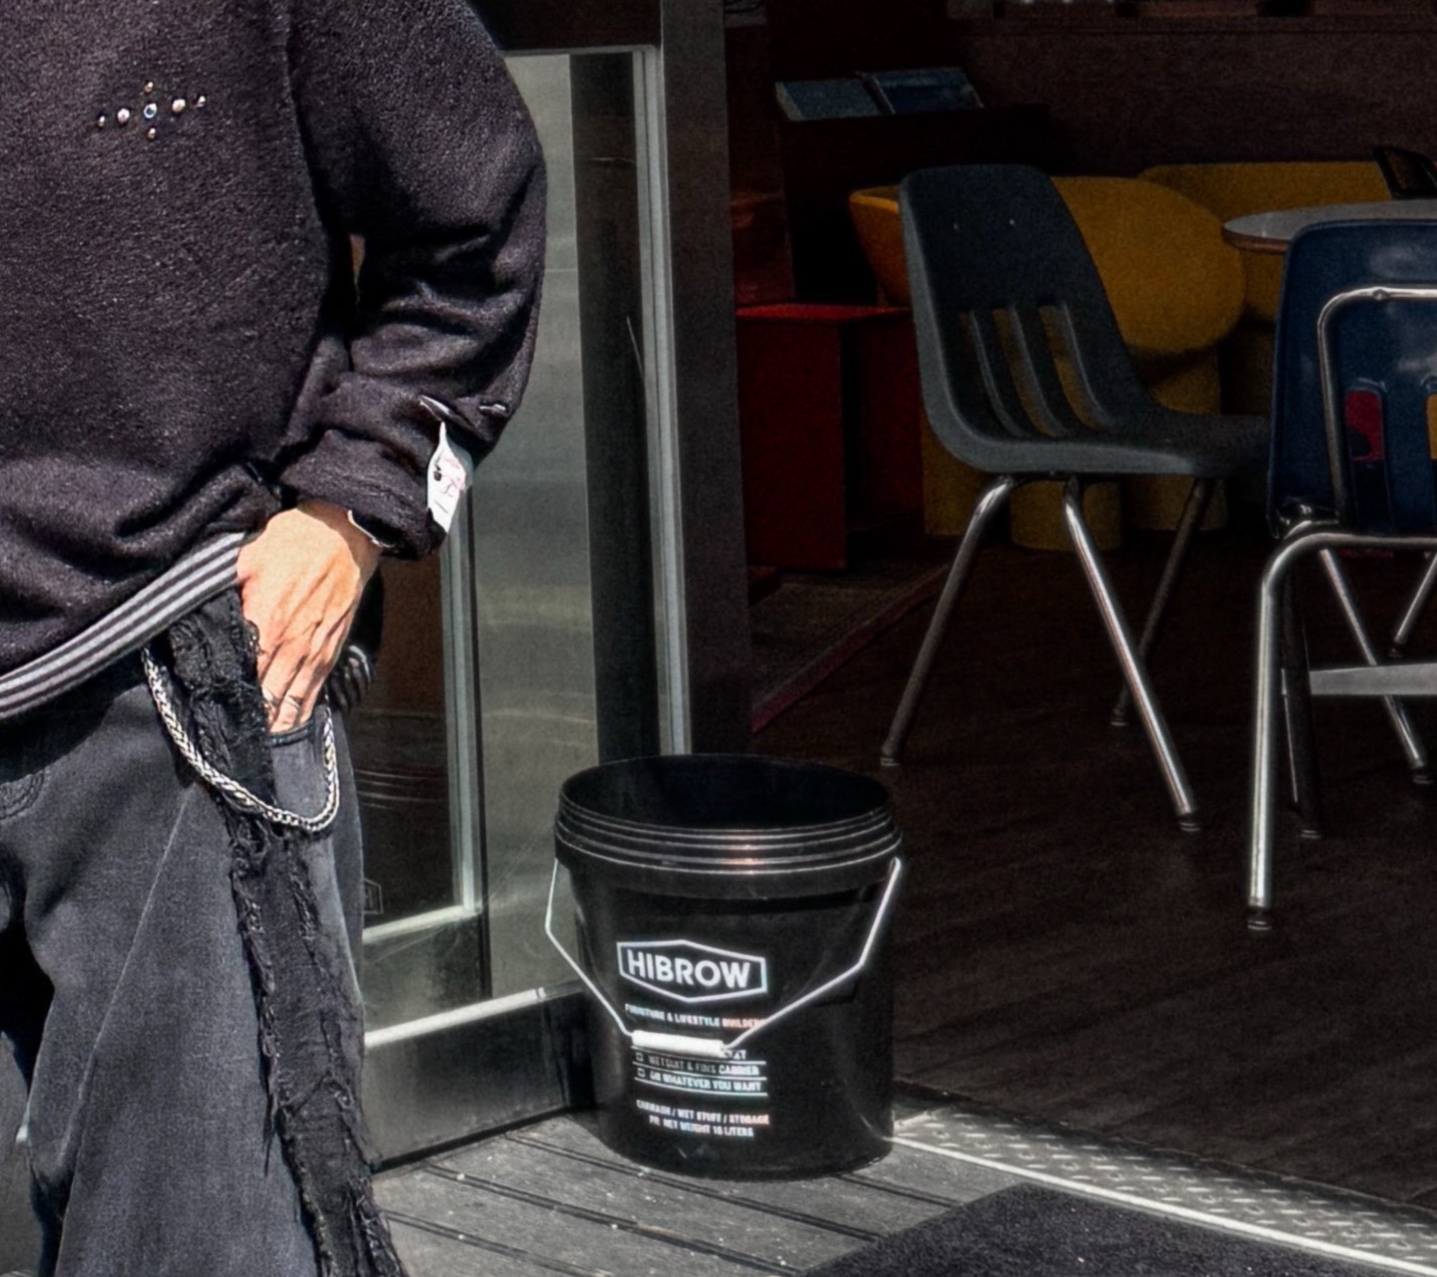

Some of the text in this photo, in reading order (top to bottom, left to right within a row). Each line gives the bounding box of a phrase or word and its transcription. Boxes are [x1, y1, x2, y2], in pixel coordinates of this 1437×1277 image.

[627, 949, 750, 989] HIBROW
[674, 1013, 720, 1027] LIFESTYLE
[663, 1073, 711, 1089] WHATEVER
[713, 1079, 732, 1091] YOU
[733, 1081, 762, 1091] WANT
[696, 1111, 722, 1123] STUFF
[680, 1121, 711, 1134] WEIGHT
[724, 1126, 755, 1137] LITERS
